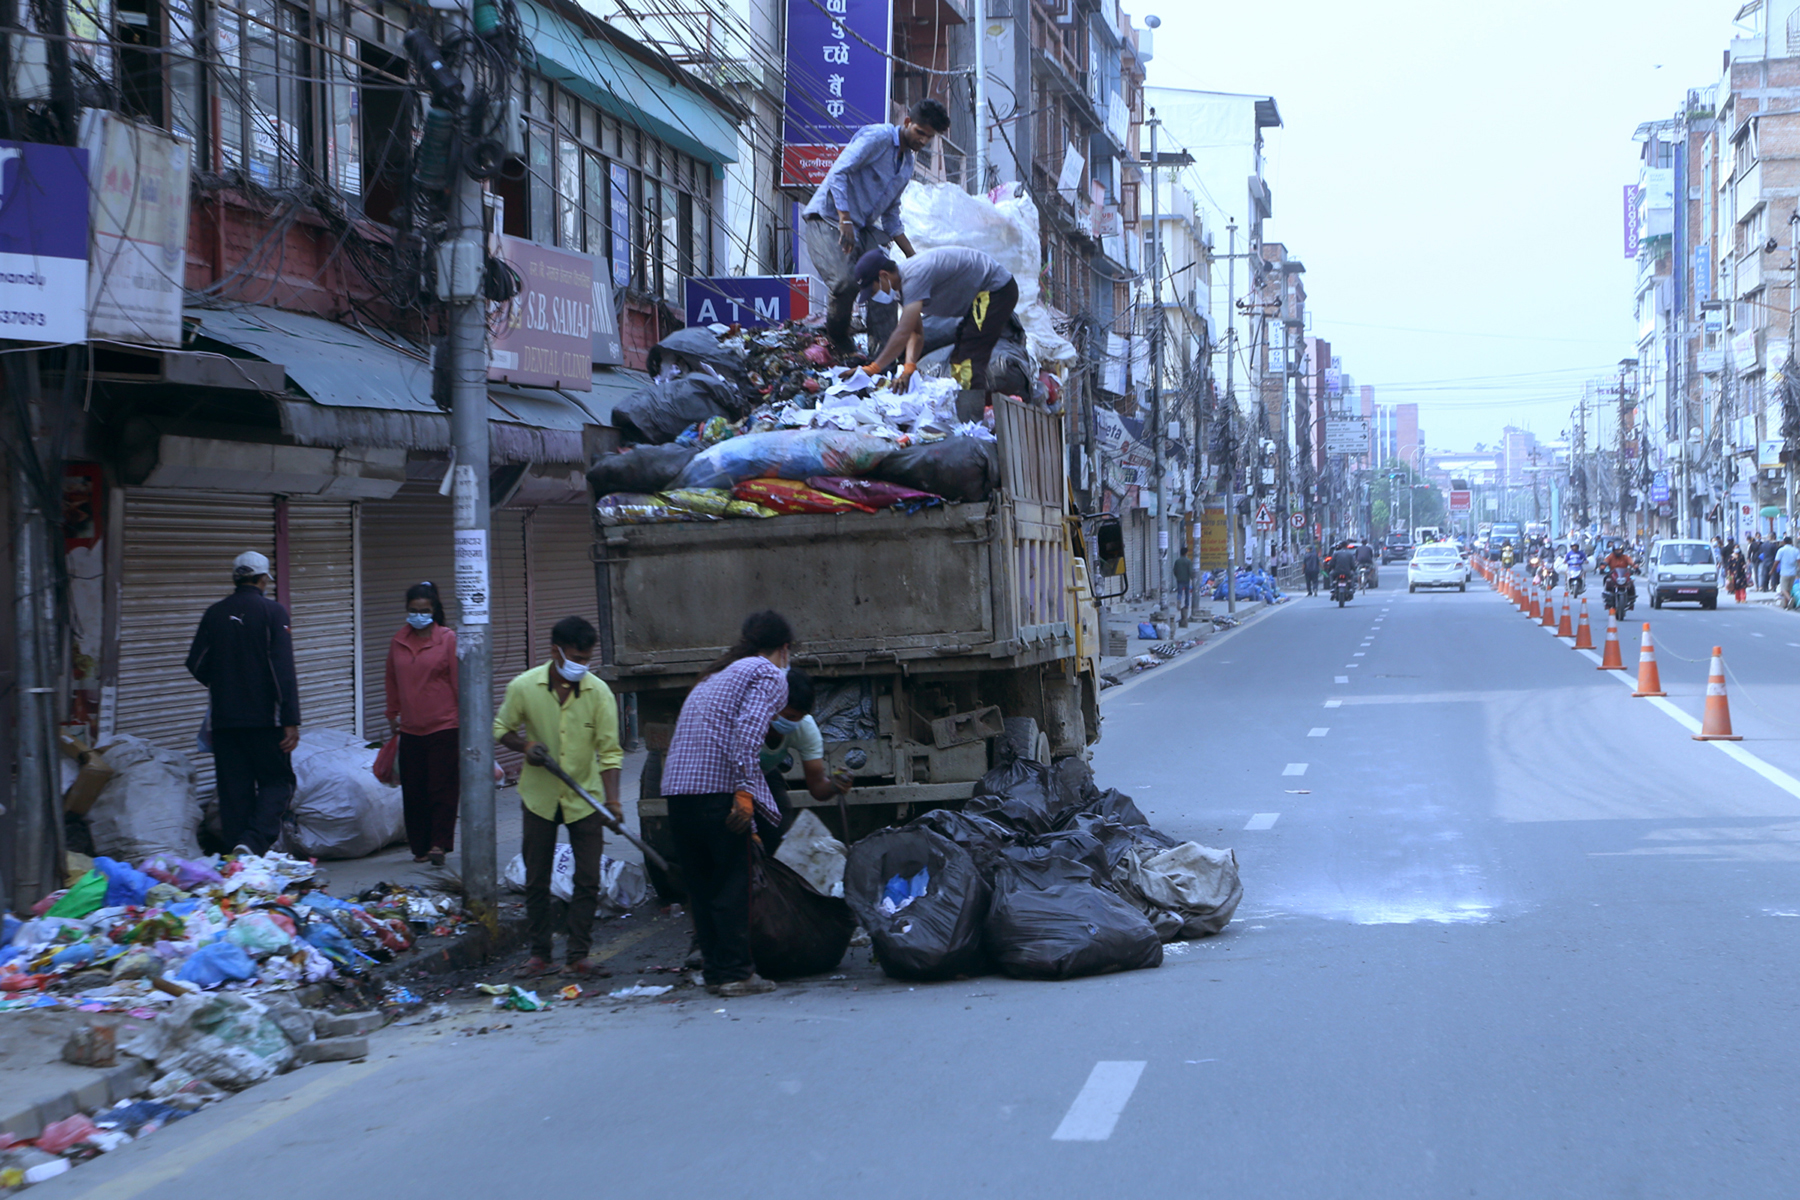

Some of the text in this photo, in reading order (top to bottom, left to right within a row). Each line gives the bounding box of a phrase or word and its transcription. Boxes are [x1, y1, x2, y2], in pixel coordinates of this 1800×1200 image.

[551, 296, 591, 339] SAMAJ
[697, 296, 780, 322] ATM
[523, 345, 591, 381] DENTAL CLINIC
